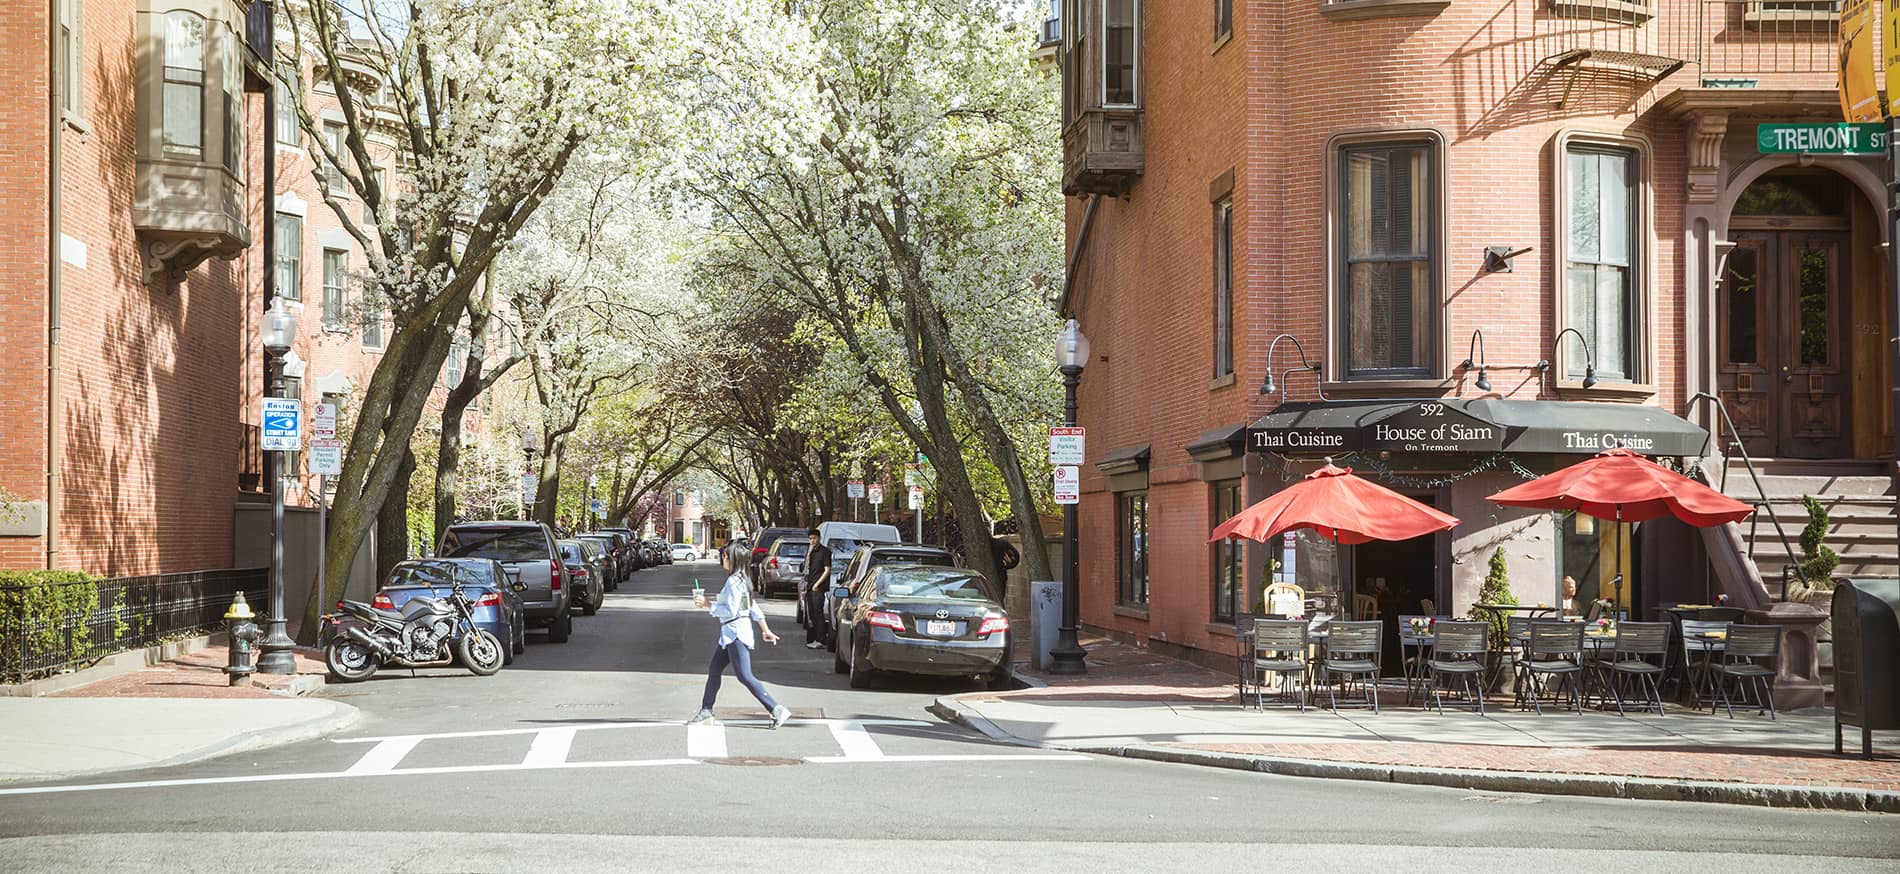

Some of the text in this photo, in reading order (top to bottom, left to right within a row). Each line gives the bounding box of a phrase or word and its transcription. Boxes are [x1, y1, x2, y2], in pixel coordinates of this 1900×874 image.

[1773, 127, 1860, 150] TREMONT
[1870, 132, 1887, 148] ST
[267, 402, 295, 410] Boston
[1420, 403, 1444, 416] 592
[1253, 431, 1343, 447] Thai Cuisine
[1375, 424, 1493, 441] House of Siam
[266, 438, 283, 446] DIAL
[1404, 443, 1459, 451] On Tremont
[1562, 431, 1653, 449] Thai Cuisine
